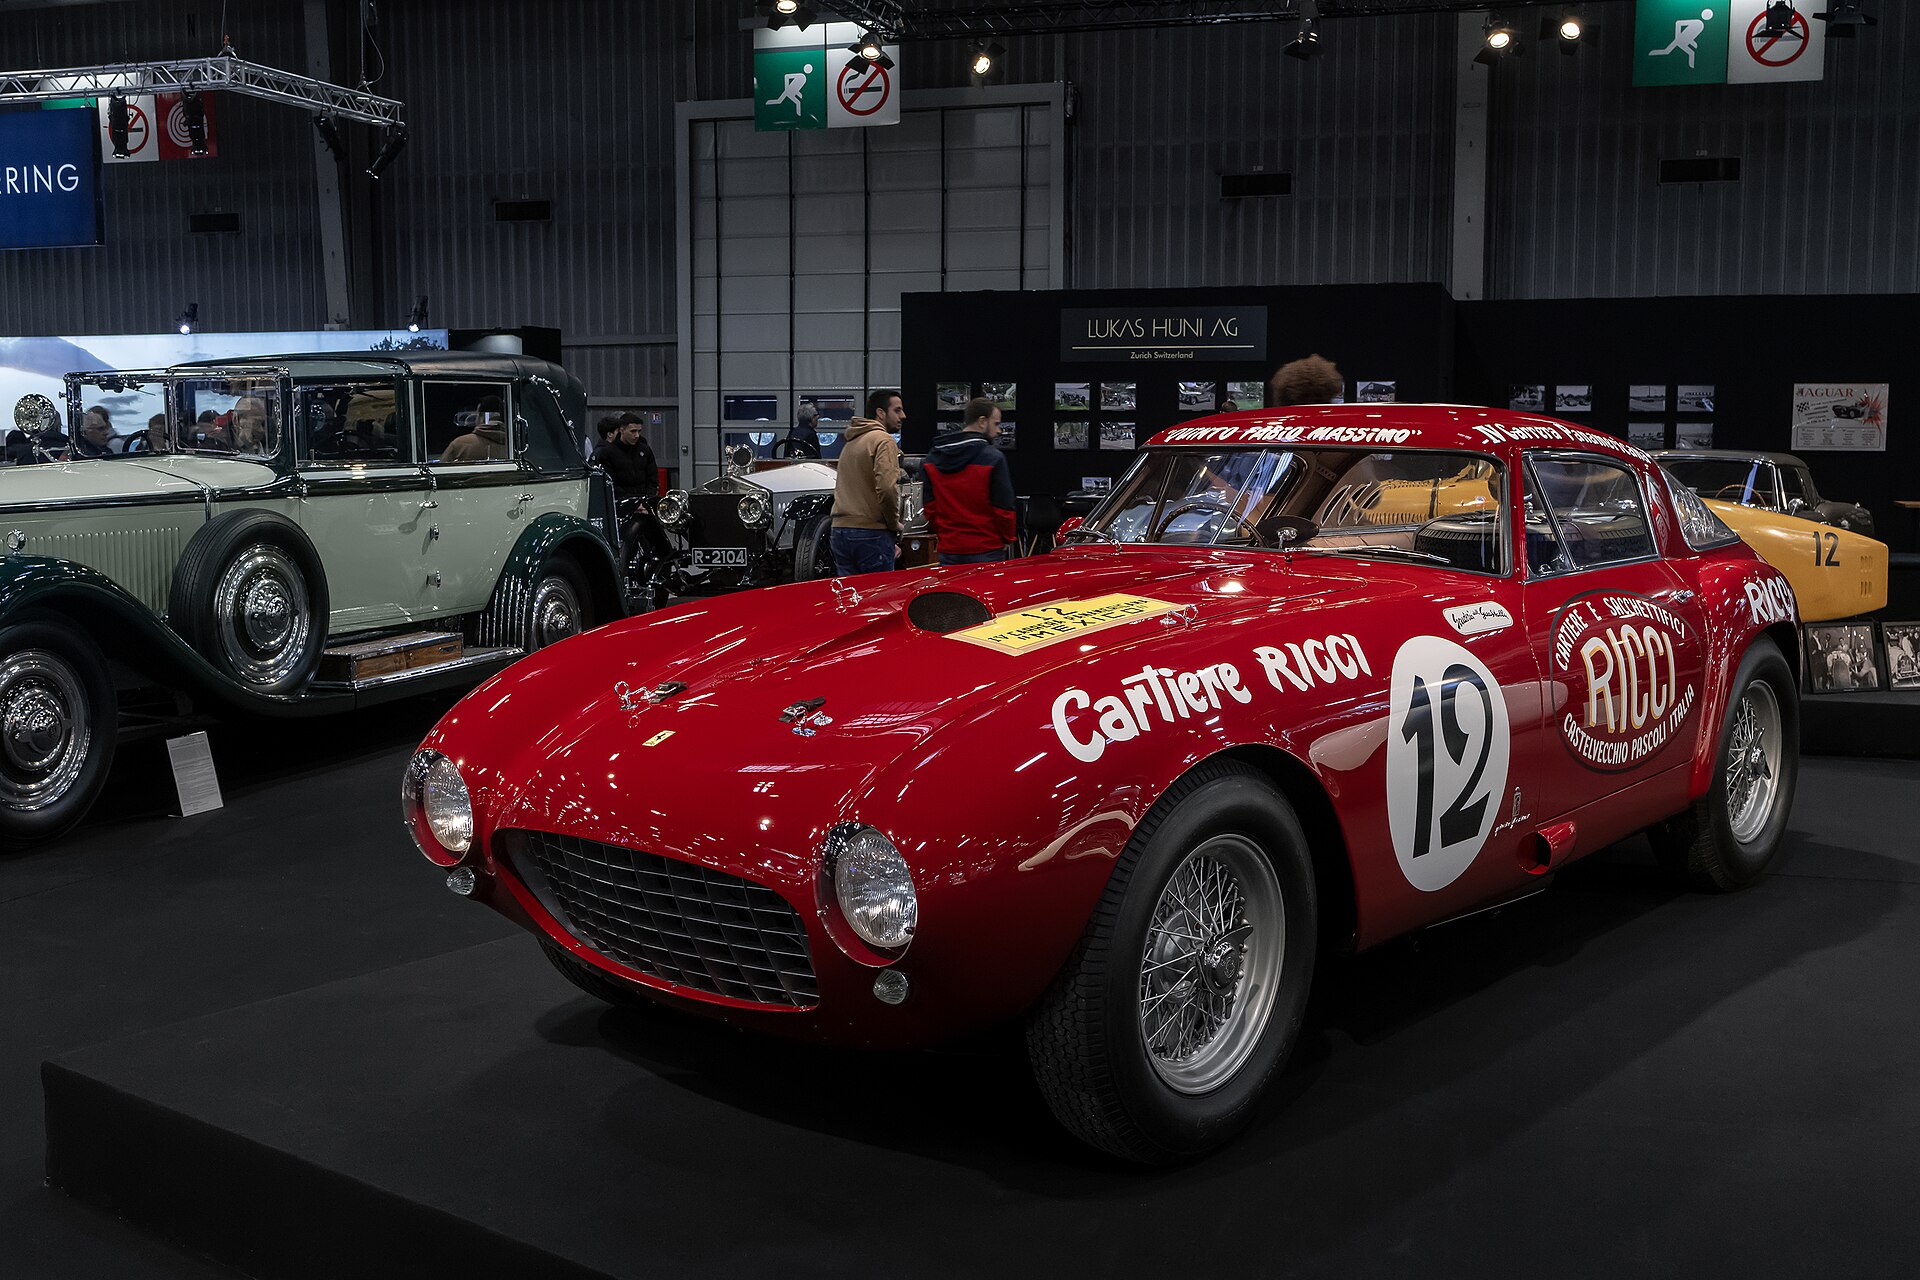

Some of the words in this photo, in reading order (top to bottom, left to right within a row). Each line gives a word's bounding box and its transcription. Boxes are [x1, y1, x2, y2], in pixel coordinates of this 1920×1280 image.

[0, 163, 79, 194] RING
[1088, 319, 1145, 338] LUKAS
[1152, 318, 1203, 337] HÜNI
[1210, 317, 1239, 337] AG
[1153, 351, 1194, 359] Switzerland
[1796, 387, 1854, 398] JAGUAR
[1494, 423, 1562, 440] Carrera
[1813, 530, 1840, 567] 12
[1556, 609, 1589, 671] CARTIERE
[1586, 601, 1602, 621] E
[1603, 596, 1685, 639] SACCHETTIFICI
[1580, 624, 1676, 733] RICCI
[1052, 662, 1252, 762] Cartiere
[1253, 634, 1372, 692] RICCI
[1563, 713, 1629, 765] CASTELVECCHIO
[1630, 721, 1667, 760] PASCOLI
[1669, 684, 1695, 732] ITALIA
[1401, 663, 1493, 859] 12
